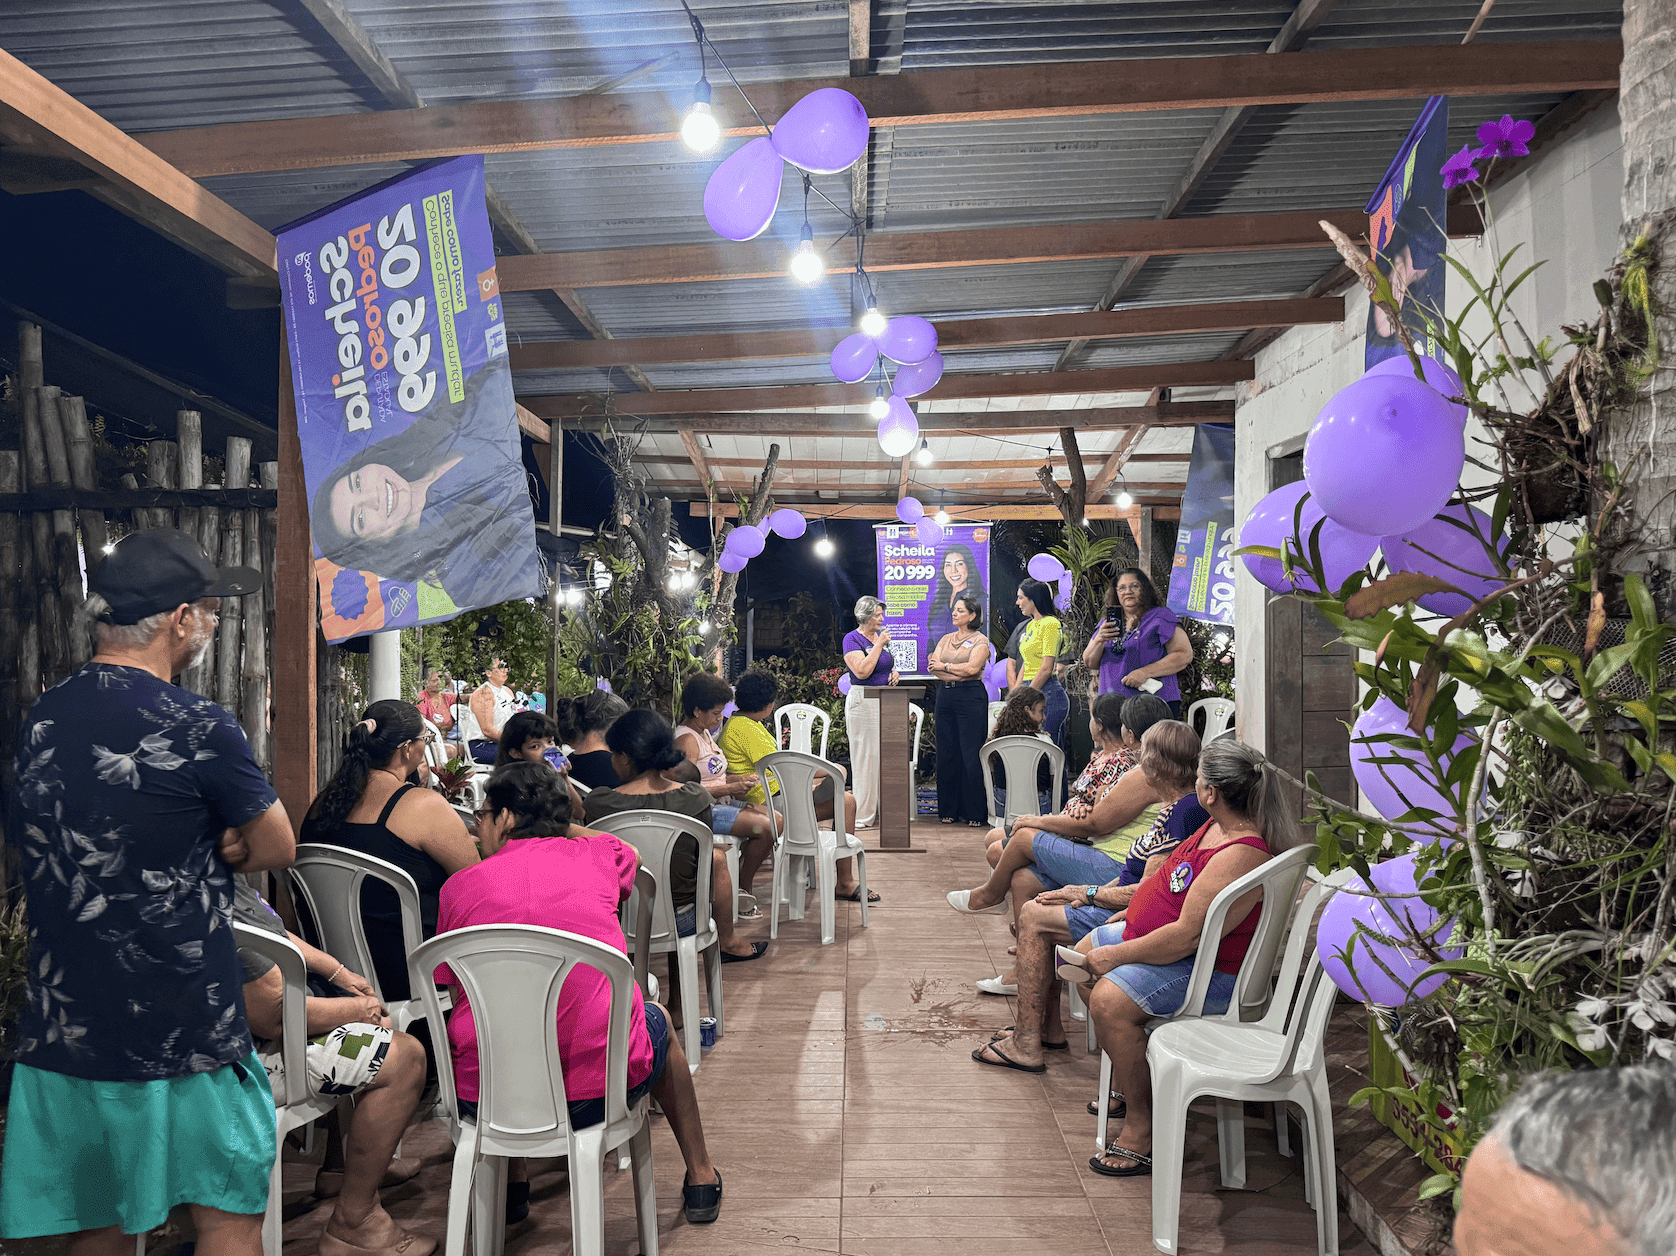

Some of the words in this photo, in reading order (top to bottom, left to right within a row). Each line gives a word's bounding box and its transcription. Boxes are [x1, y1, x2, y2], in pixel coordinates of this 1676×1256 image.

[884, 544, 935, 556] Scheila
[885, 557, 921, 565] Pedroso
[885, 565, 904, 580] 20
[906, 565, 936, 580] 999
